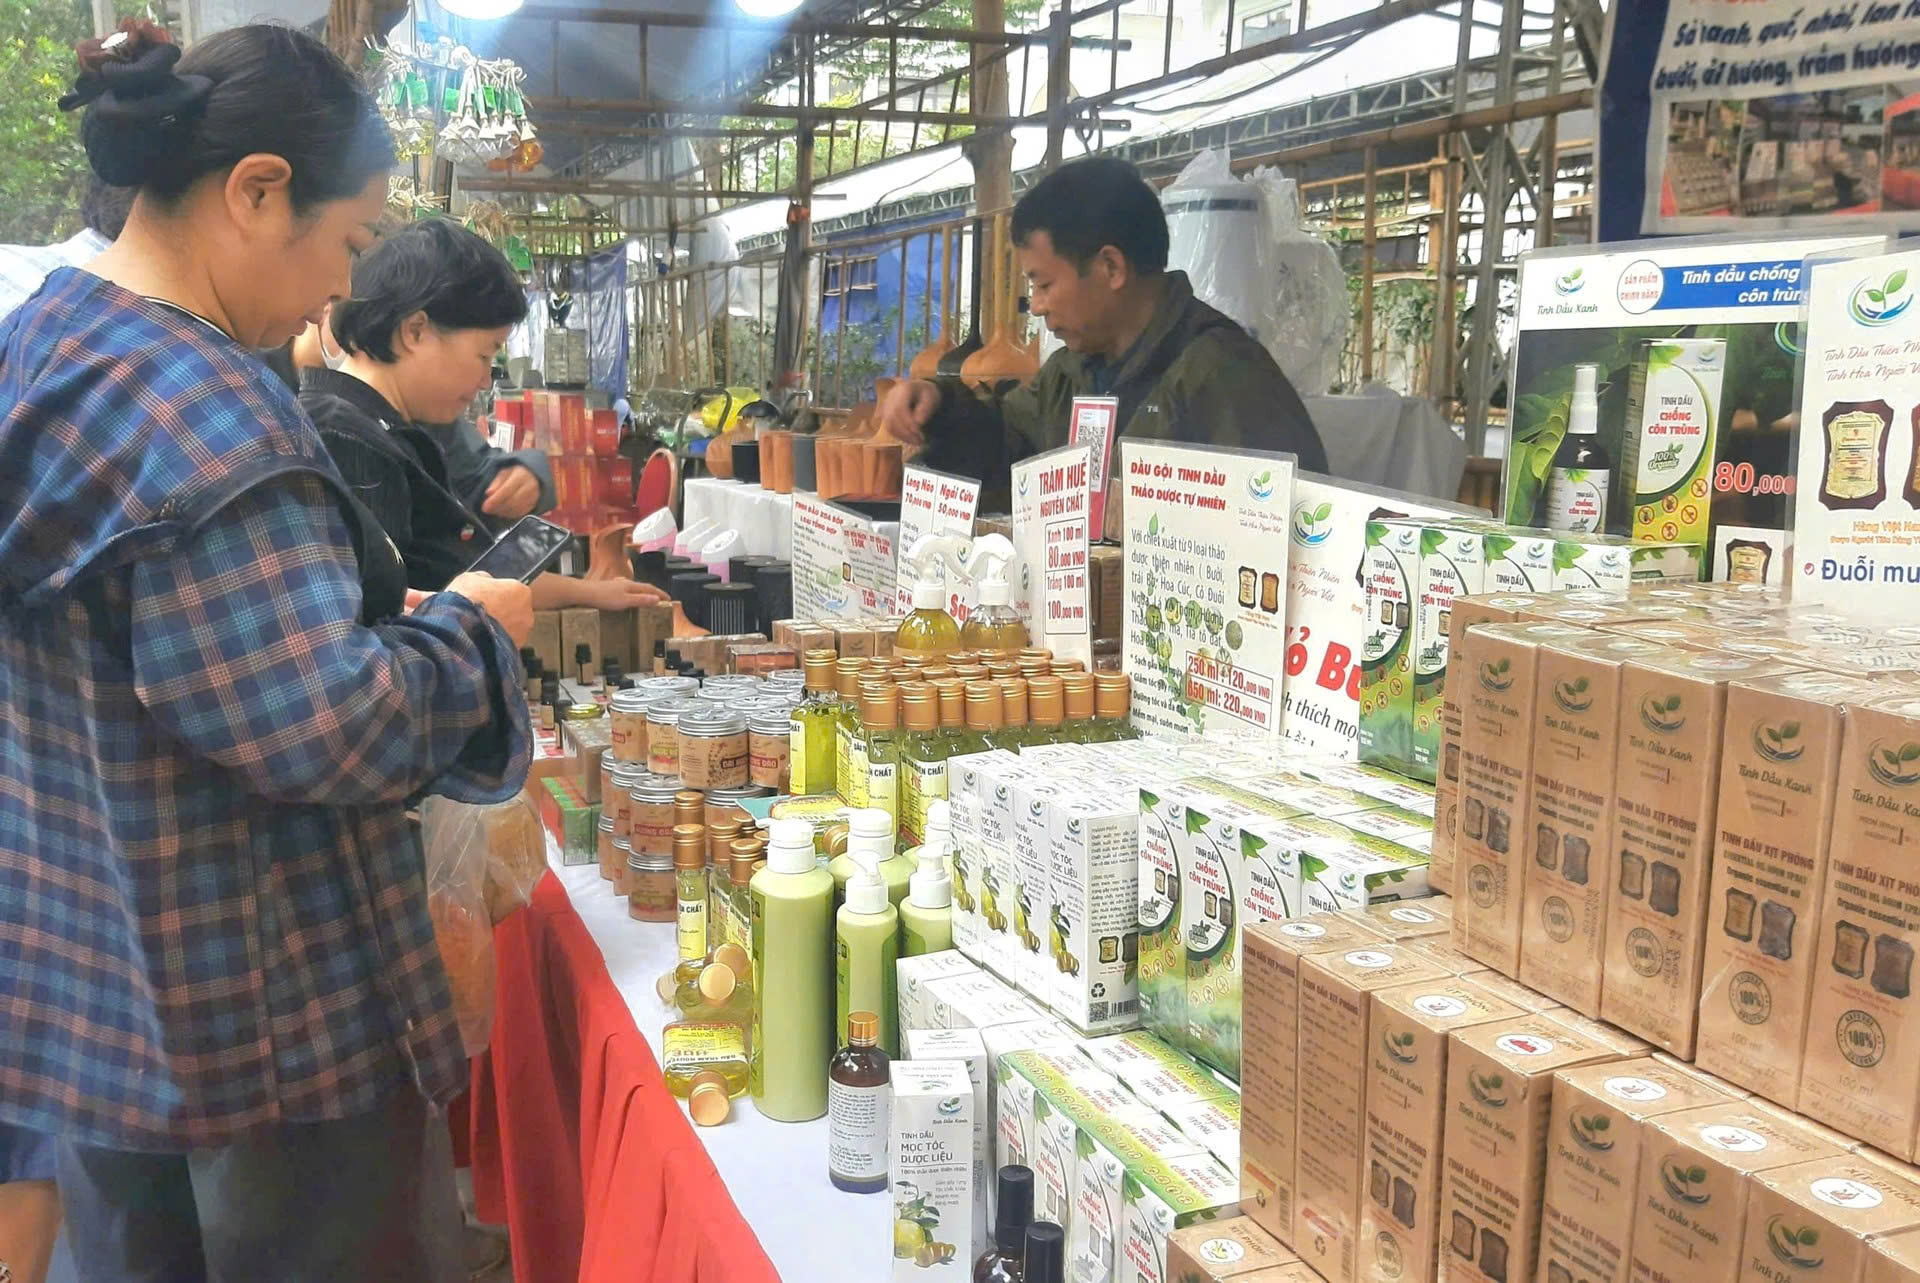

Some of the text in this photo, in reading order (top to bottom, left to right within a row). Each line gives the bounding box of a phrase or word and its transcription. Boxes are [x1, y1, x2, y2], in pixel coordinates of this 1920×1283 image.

[1682, 262, 1801, 285] Tinh dầu chống
[1738, 287, 1769, 303] côn
[1537, 304, 1554, 315] Tinh
[1575, 303, 1598, 314] Xanh
[1039, 453, 1087, 497] TRÀM HUẾ
[1131, 456, 1226, 487] DẦU GỘI TINH DẦU
[1131, 483, 1155, 499] THẢO
[1156, 489, 1182, 506] DƯỢC
[1196, 495, 1227, 511] NHIÊN
[1062, 526, 1074, 542] 100
[1131, 528, 1143, 544] Với
[1162, 536, 1178, 551] xuất
[1187, 540, 1193, 553] 9
[1193, 540, 1207, 560] loại
[1208, 544, 1226, 561] thảo
[1174, 560, 1195, 576] nhiên
[1429, 567, 1442, 578] TINH
[1063, 574, 1074, 590] 100
[1131, 570, 1144, 585] trái
[1160, 576, 1175, 592] Hoa
[1177, 579, 1192, 599] Cúc,
[1195, 582, 1205, 600] Cỏ
[1373, 570, 1396, 586] CHỐNG
[1495, 574, 1511, 586] TINH
[1379, 586, 1403, 600] TRÙNG
[1429, 579, 1455, 595] CHỐNG
[1188, 655, 1206, 677] 250
[1206, 659, 1220, 682] ml
[1296, 698, 1331, 729] thích
[874, 766, 893, 778] CHẤT
[928, 763, 945, 777] CHẤT
[1738, 763, 1760, 780] Tinh
[1784, 777, 1812, 796] Xanh
[1852, 788, 1900, 812] Tinh Dầu
[1146, 839, 1167, 856] CHỐNG
[1195, 846, 1207, 858] TINH
[1721, 830, 1743, 848] TINH
[1780, 848, 1815, 871] PHÒNG
[1152, 855, 1173, 872] TRÙNG
[1195, 860, 1219, 878] CHỐNG
[1188, 871, 1226, 894] CÔN TRÙNG
[1250, 871, 1263, 885] TINH
[1832, 859, 1855, 877] TINH
[1878, 874, 1897, 890] XỊT
[1243, 897, 1257, 911] CÔN
[1250, 886, 1275, 906] CHỐNG
[1308, 895, 1322, 909] TINH
[686, 904, 703, 914] CHẤT
[901, 1132, 919, 1140] TINH
[901, 1140, 945, 1155] MỌC TÓC
[901, 1151, 954, 1166] DƯỢC LIỆU
[1648, 1194, 1720, 1246] Tinh Dầu Xanh
[1751, 1257, 1773, 1280] Tinh
